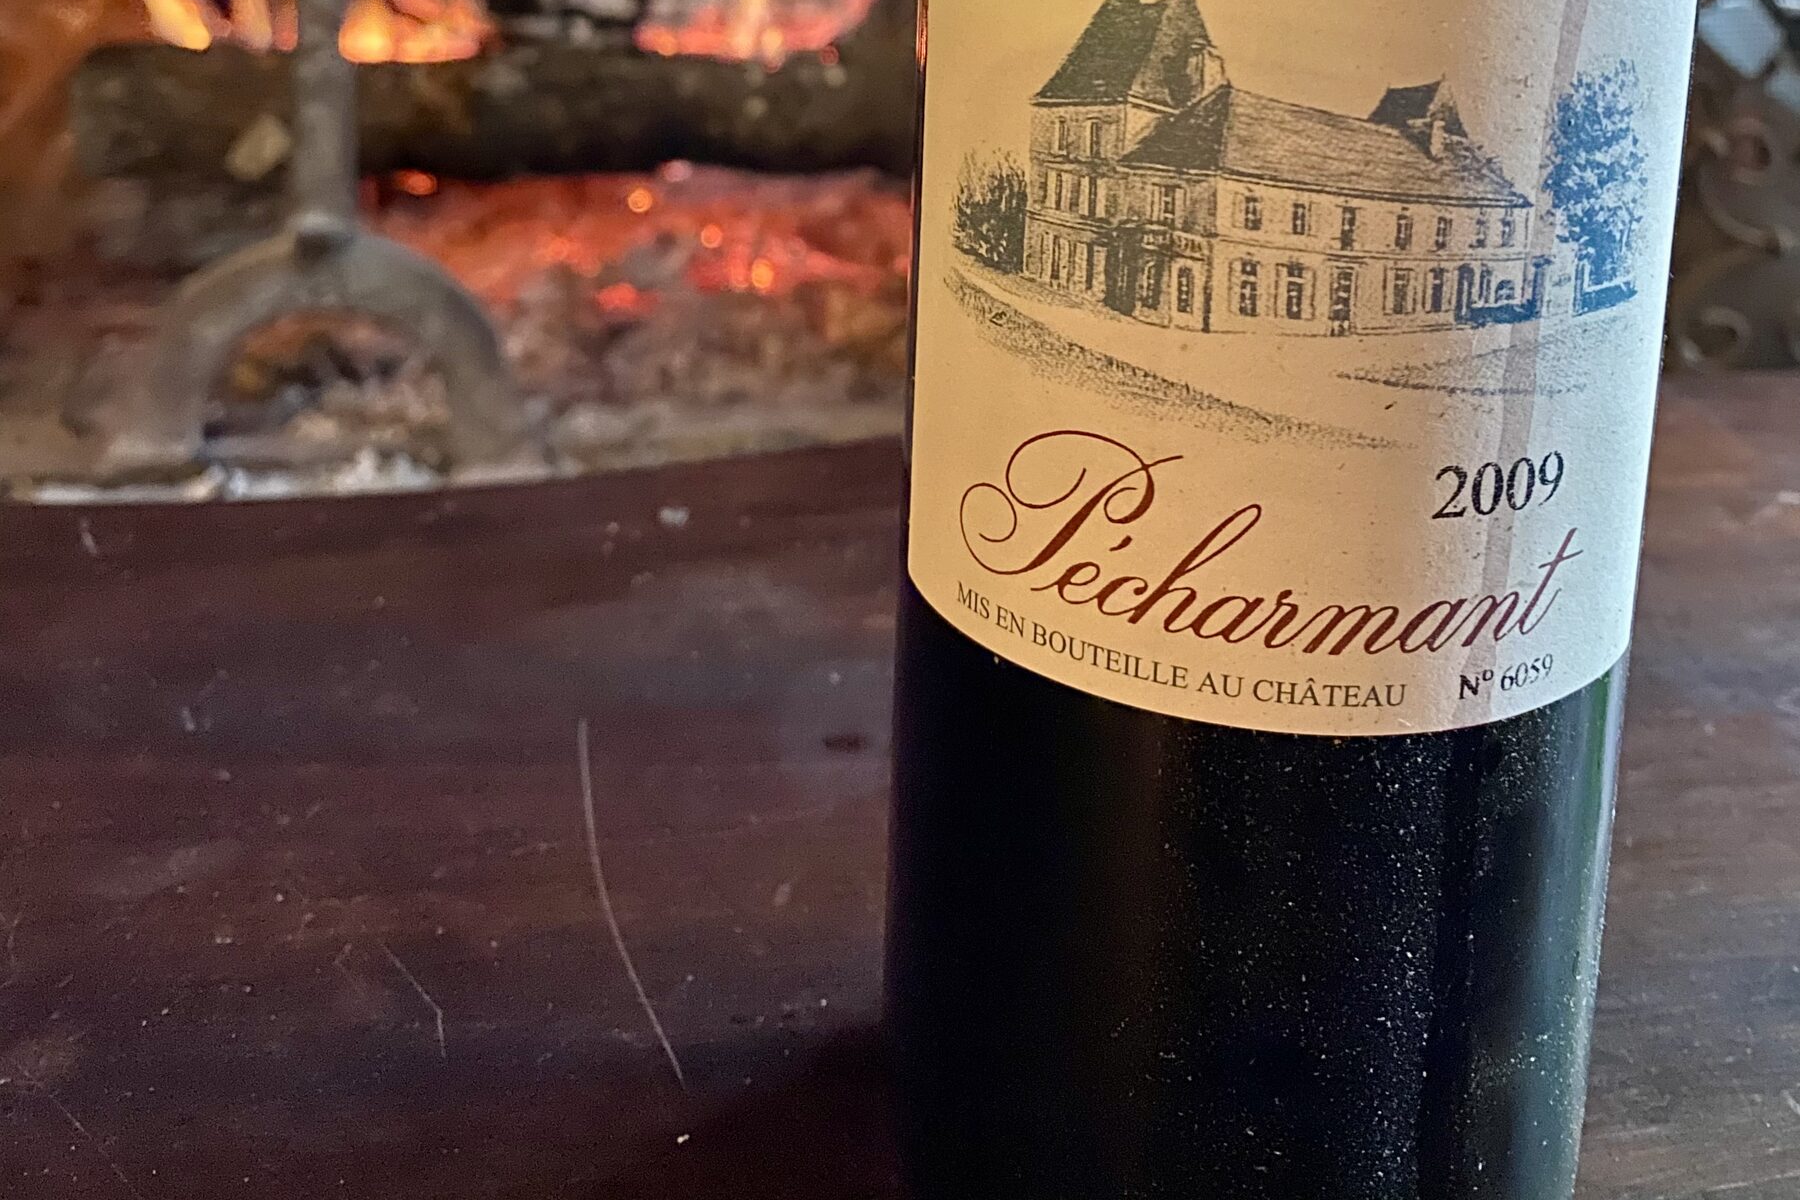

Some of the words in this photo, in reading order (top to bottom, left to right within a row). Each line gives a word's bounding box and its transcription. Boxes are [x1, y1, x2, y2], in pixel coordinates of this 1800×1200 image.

[1432, 451, 1565, 520] 2009
[960, 430, 1583, 656] Pécharmant
[957, 581, 990, 620] MIS
[995, 604, 1025, 638] EN
[1031, 621, 1188, 689] BOUTEILLE
[1196, 671, 1245, 698] AU
[1252, 677, 1406, 708] CHÂTEAU
[1500, 653, 1554, 692] 6059
